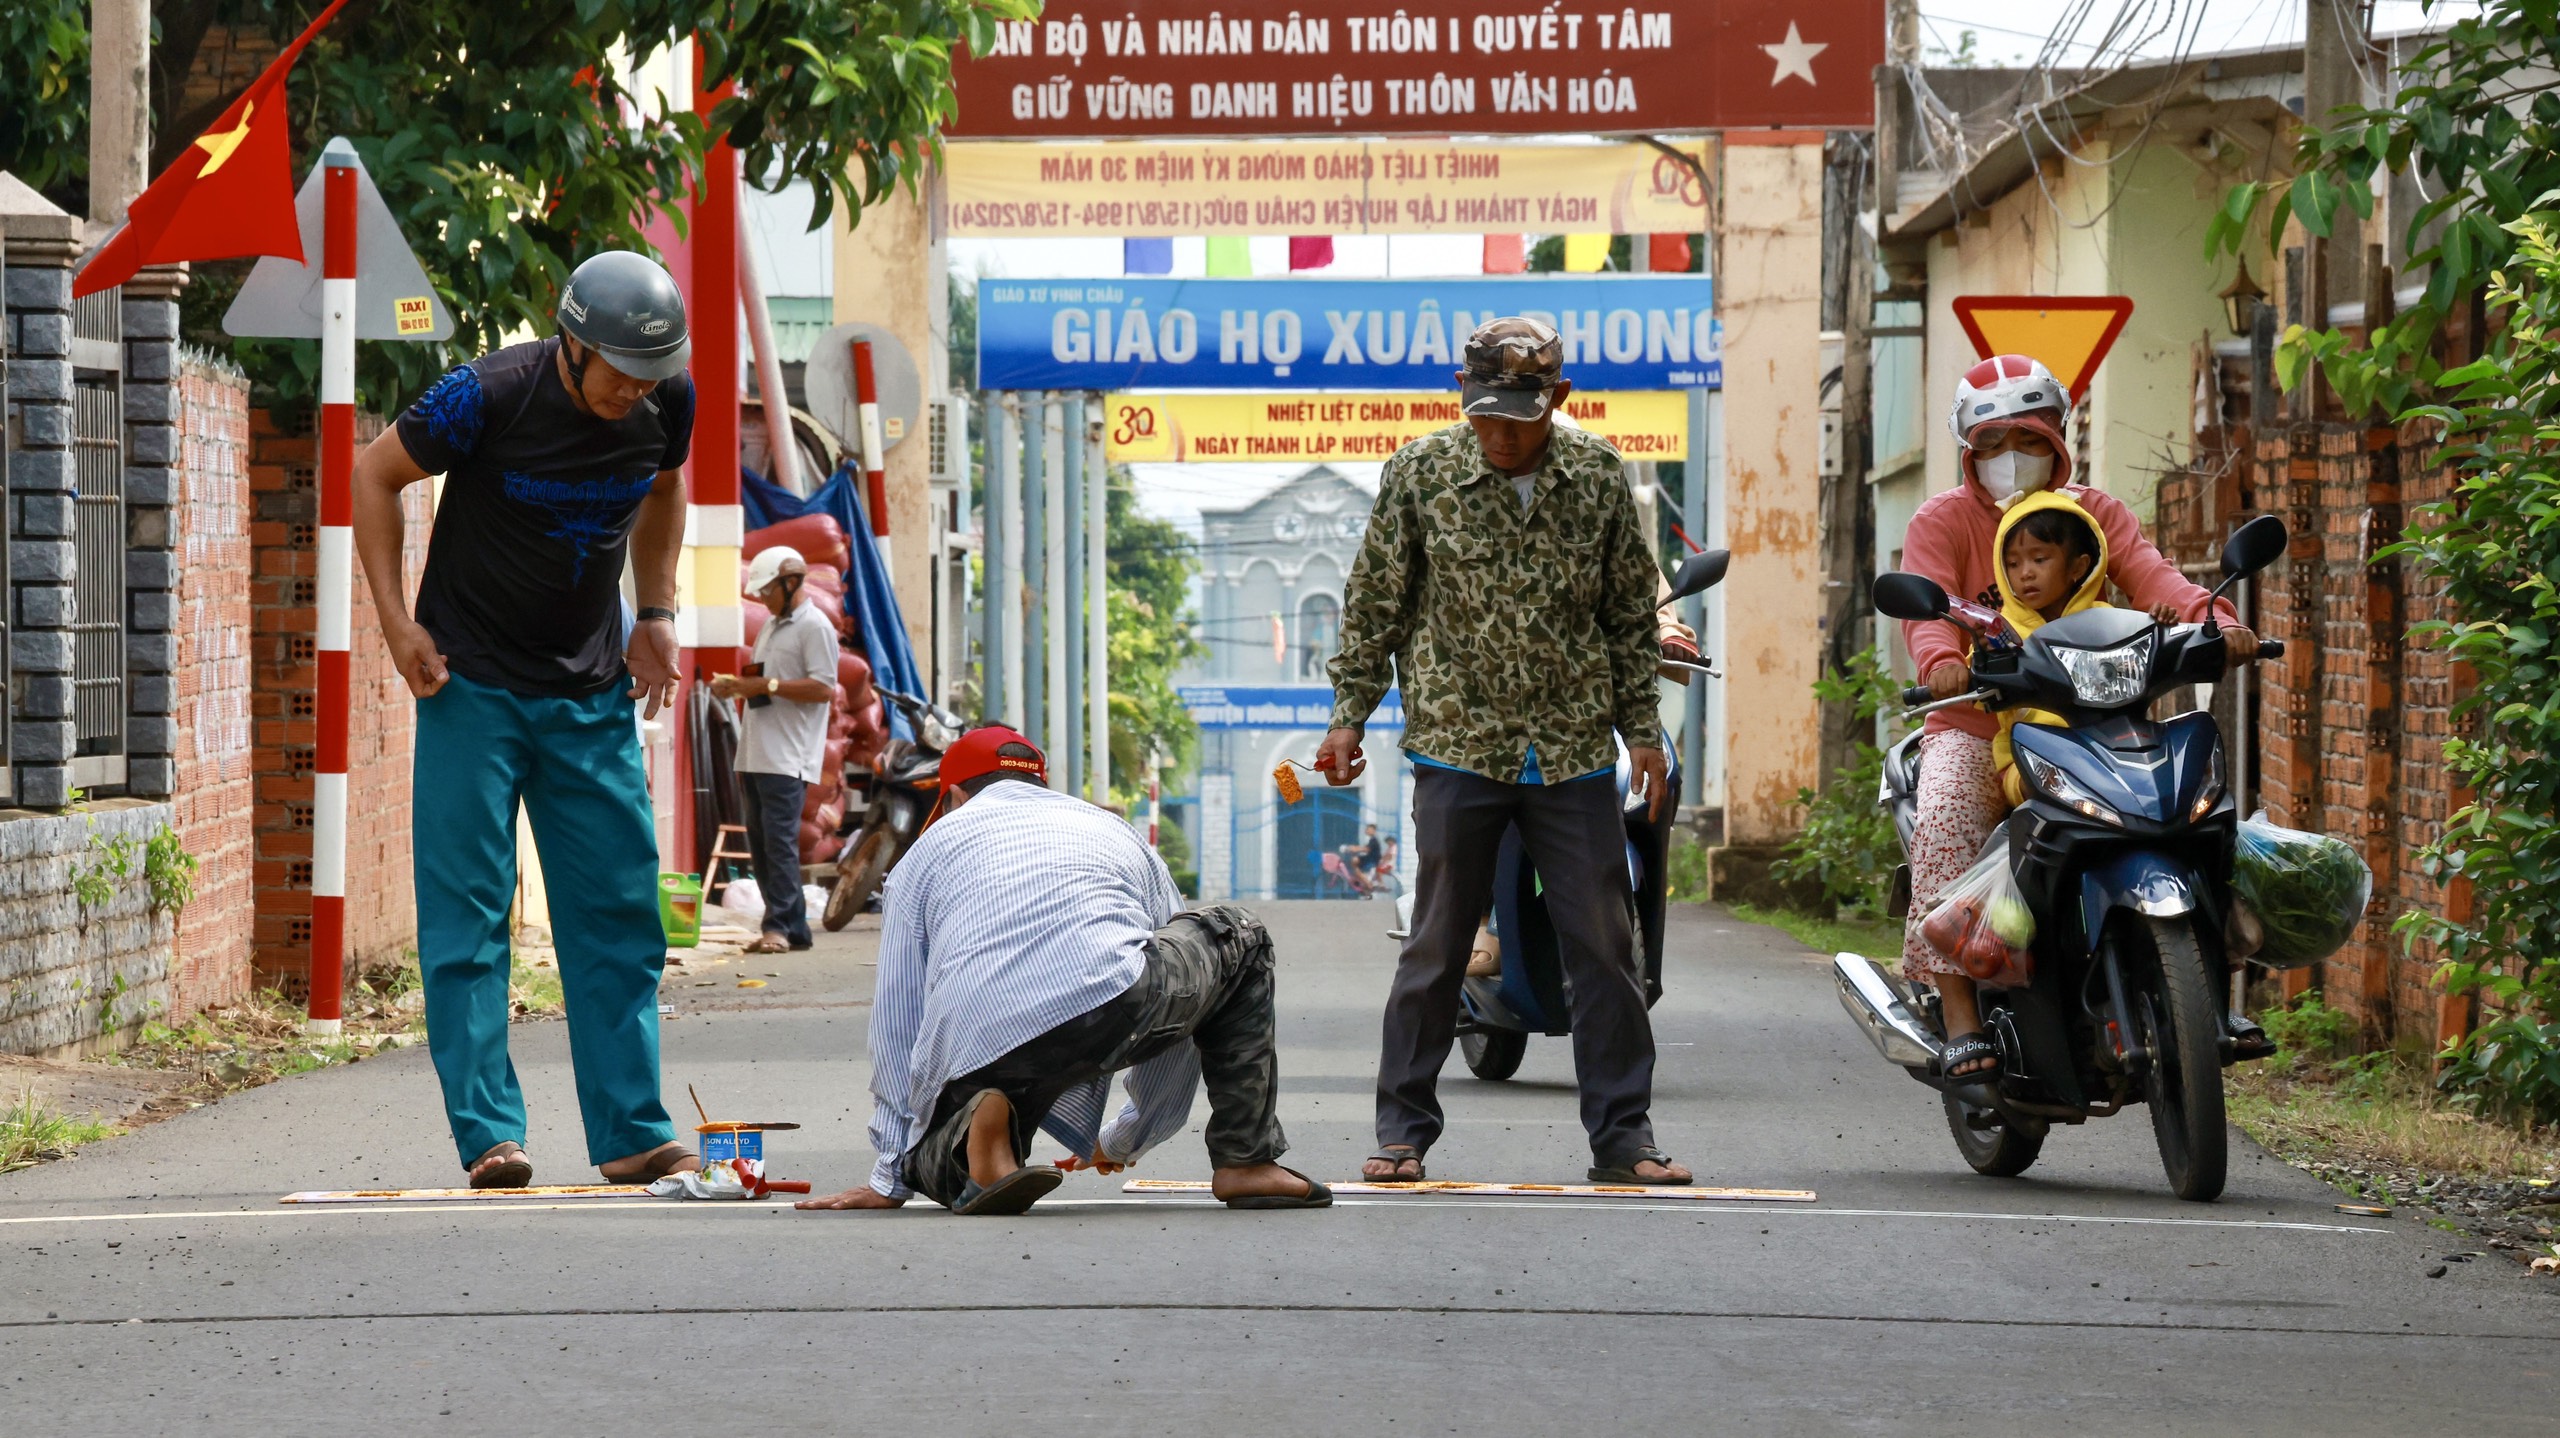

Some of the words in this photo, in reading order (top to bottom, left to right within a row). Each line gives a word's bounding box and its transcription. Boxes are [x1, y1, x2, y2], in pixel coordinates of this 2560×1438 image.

[1045, 13, 1088, 67] BỘ
[1101, 12, 1146, 57] VÀ
[1158, 11, 1252, 56] NHÂN
[1263, 11, 1329, 55] DÂN
[1347, 9, 1437, 53] THÔN
[1473, 1, 1583, 54] QUYẾT
[1597, 7, 1672, 50] TÂM
[1012, 74, 1073, 120] GIỮ
[1085, 75, 1174, 120] VỮNG
[1190, 82, 1278, 119] DANH
[1292, 73, 1373, 127] HIỆU
[1385, 71, 1475, 115] THÔN
[1490, 70, 1558, 113] VĂN
[1567, 68, 1638, 113] HÓA
[400, 300, 426, 313] TAXI
[1051, 297, 1199, 364] GIÁO
[1219, 309, 1303, 378] HỌ
[1519, 308, 1723, 365] HONG
[1267, 400, 1315, 427] NHIỆT
[1321, 400, 1355, 427] LIỆT
[1360, 398, 1404, 422] CHÀO
[1410, 398, 1460, 421] MỪNG
[1567, 398, 1606, 420] NĂM
[1195, 433, 1239, 455] NGÀY
[1245, 432, 1299, 454] THÀNH
[1306, 432, 1336, 459] LẬP
[1343, 432, 1397, 459] HUYỆN
[722, 1137, 750, 1146] ALYD
